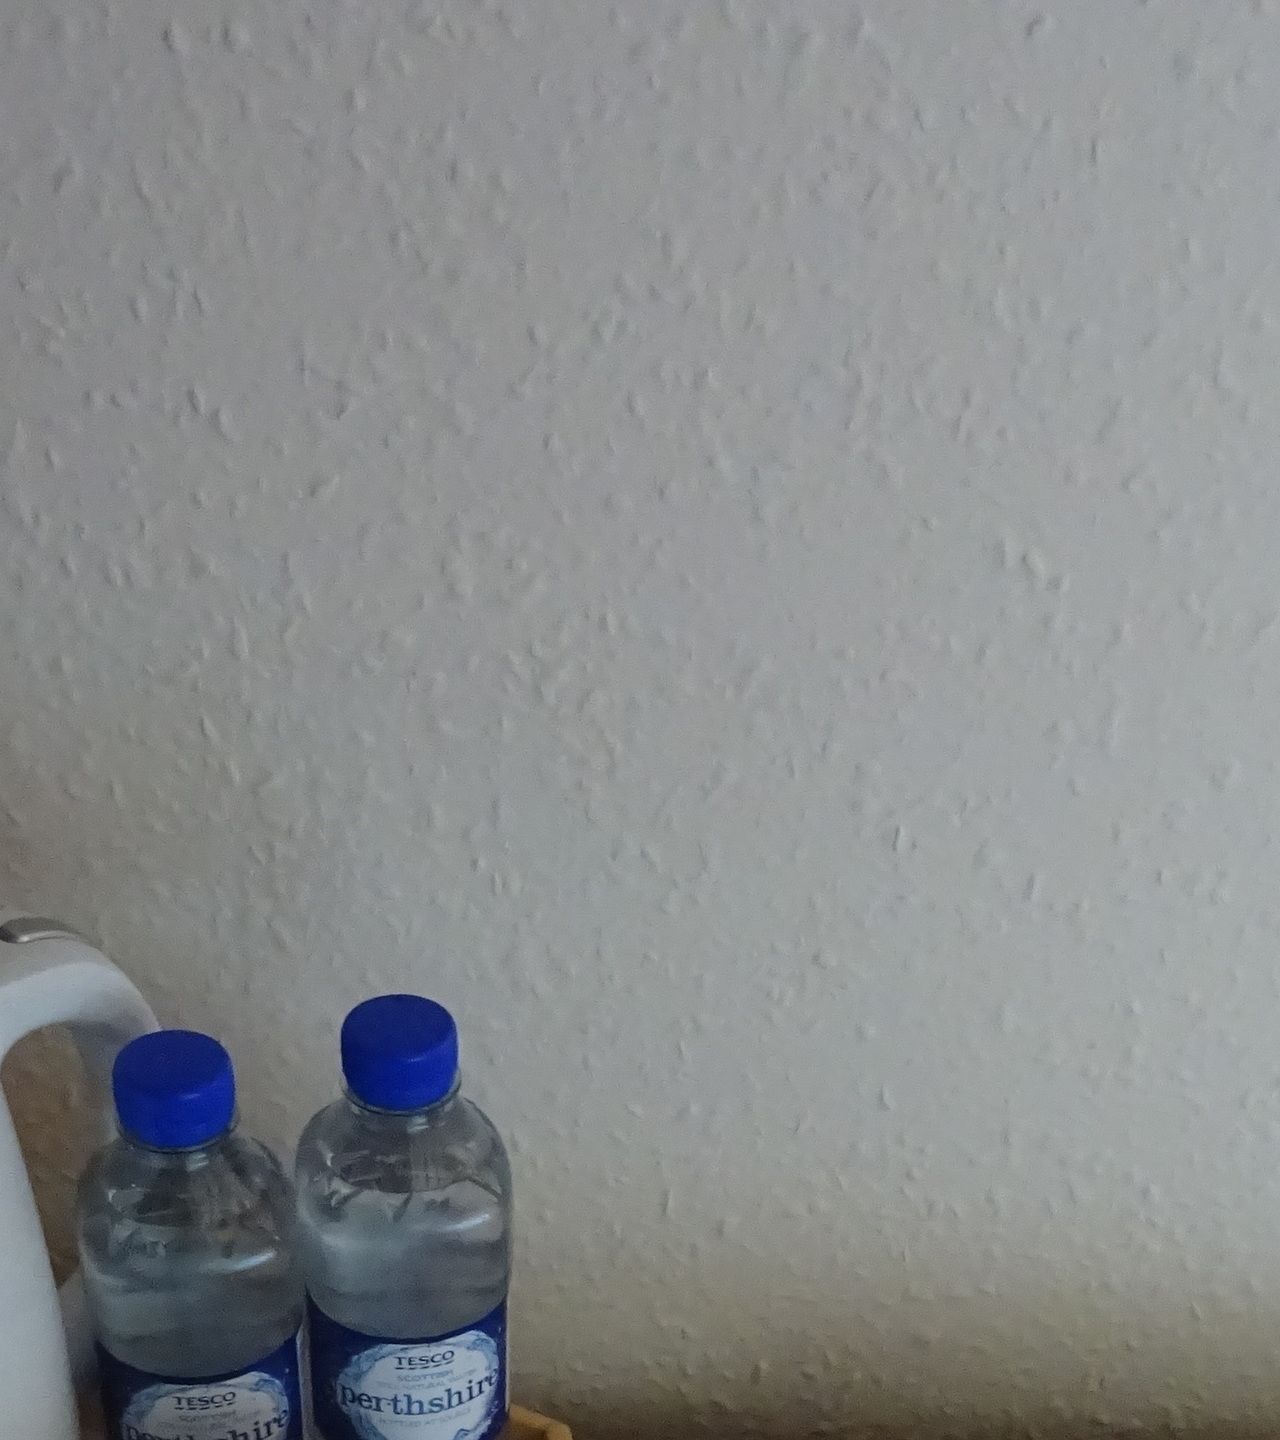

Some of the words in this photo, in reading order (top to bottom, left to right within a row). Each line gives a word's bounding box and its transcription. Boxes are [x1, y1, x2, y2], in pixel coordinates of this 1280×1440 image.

[393, 1350, 456, 1368] TESCO
[172, 1391, 237, 1408] TESCO
[339, 1368, 498, 1416] perthshire
